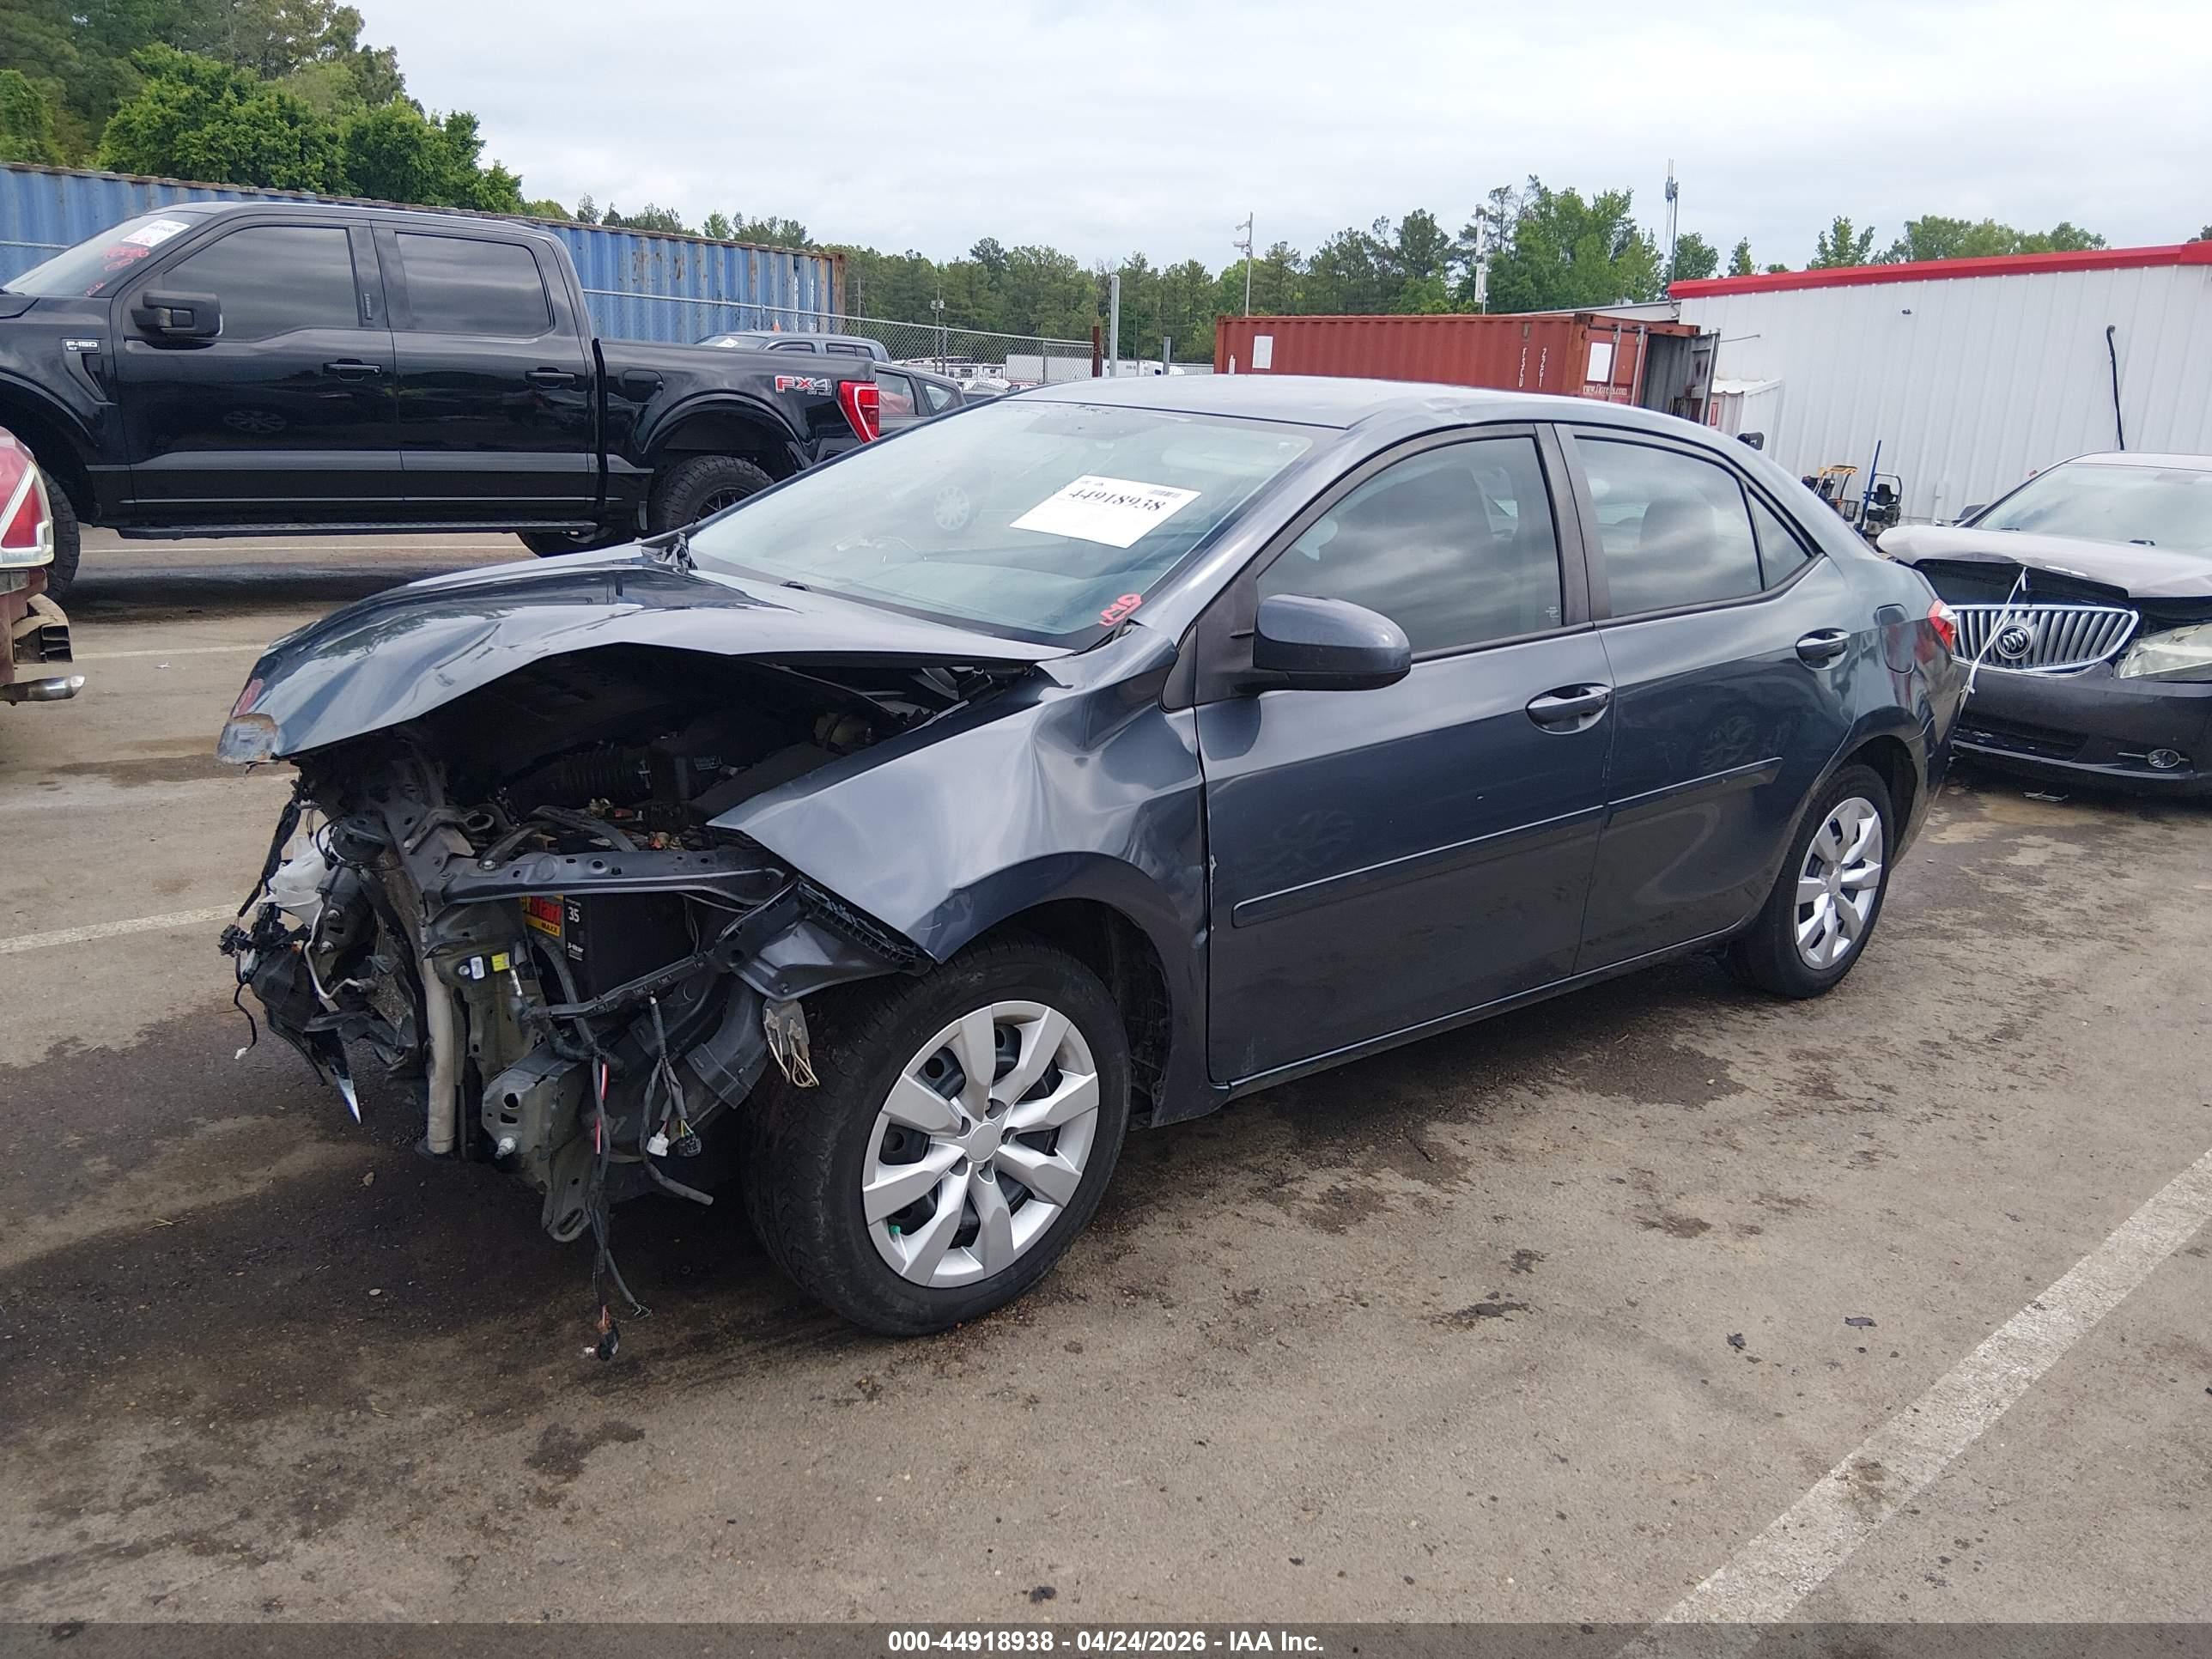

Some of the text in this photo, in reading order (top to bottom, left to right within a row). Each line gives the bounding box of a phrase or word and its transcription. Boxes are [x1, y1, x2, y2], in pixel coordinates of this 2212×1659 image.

[775, 374, 832, 393] FX4
[1583, 383, 1628, 397] www.flores.com
[1069, 488, 1166, 512] 44918938
[568, 906, 580, 923] 35
